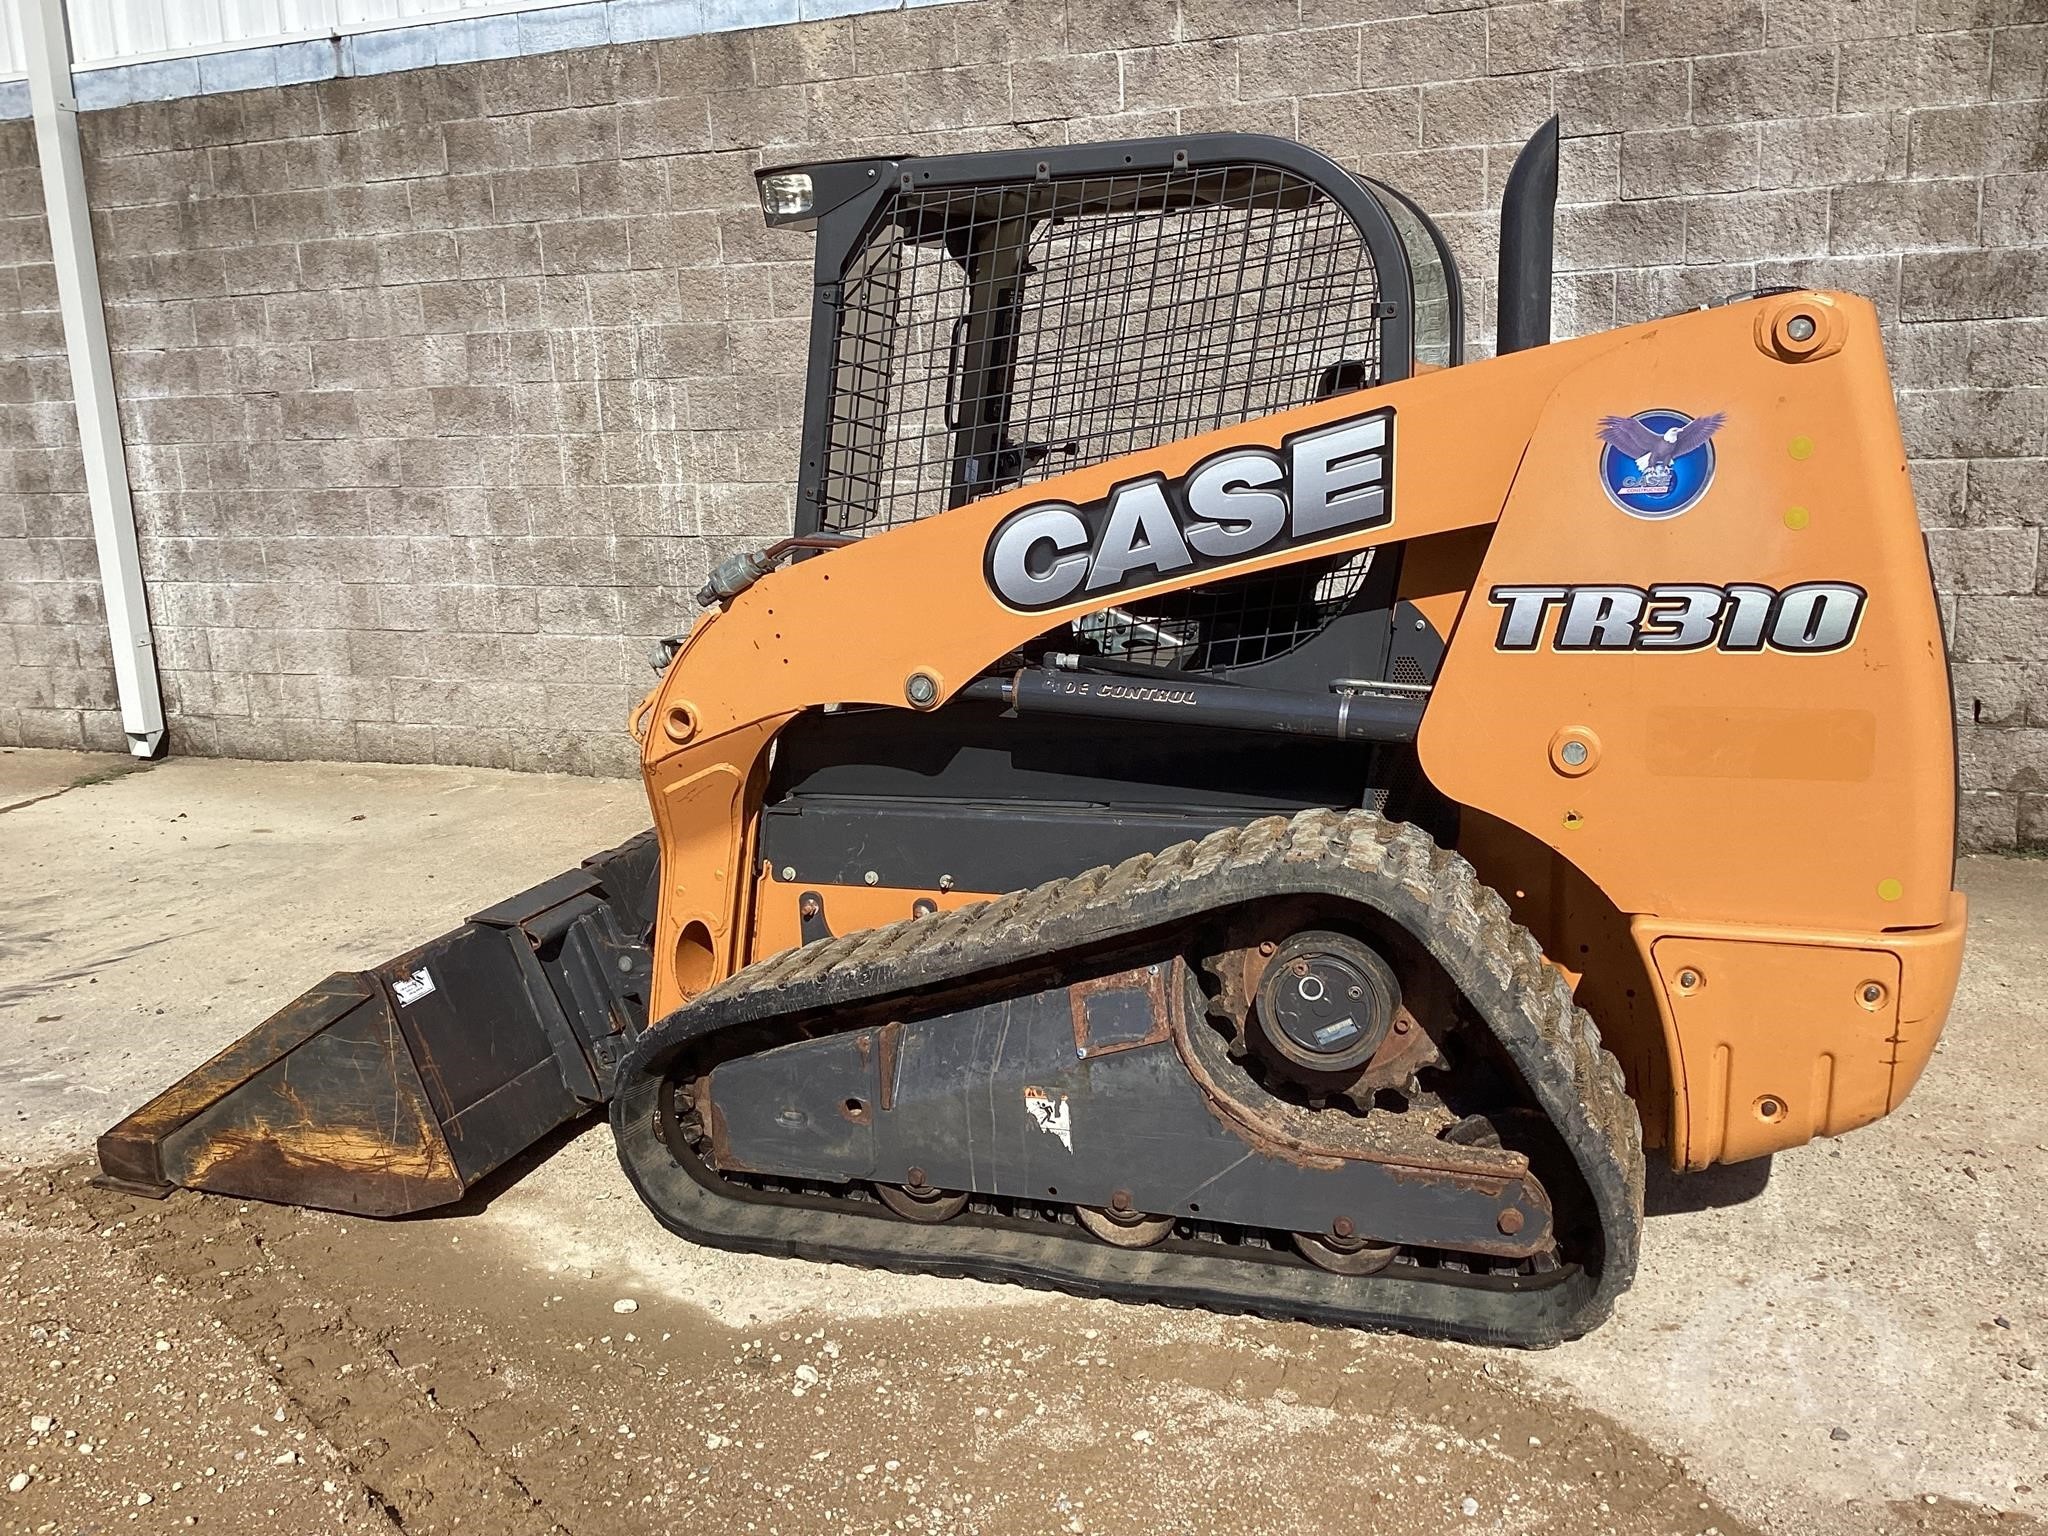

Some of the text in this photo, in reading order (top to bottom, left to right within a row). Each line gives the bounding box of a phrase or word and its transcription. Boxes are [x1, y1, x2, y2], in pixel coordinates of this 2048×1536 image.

[1622, 475, 1673, 487] CASE
[990, 415, 1388, 608] CASE
[1494, 585, 1865, 650] TR310
[1096, 683, 1197, 705] CONTROL
